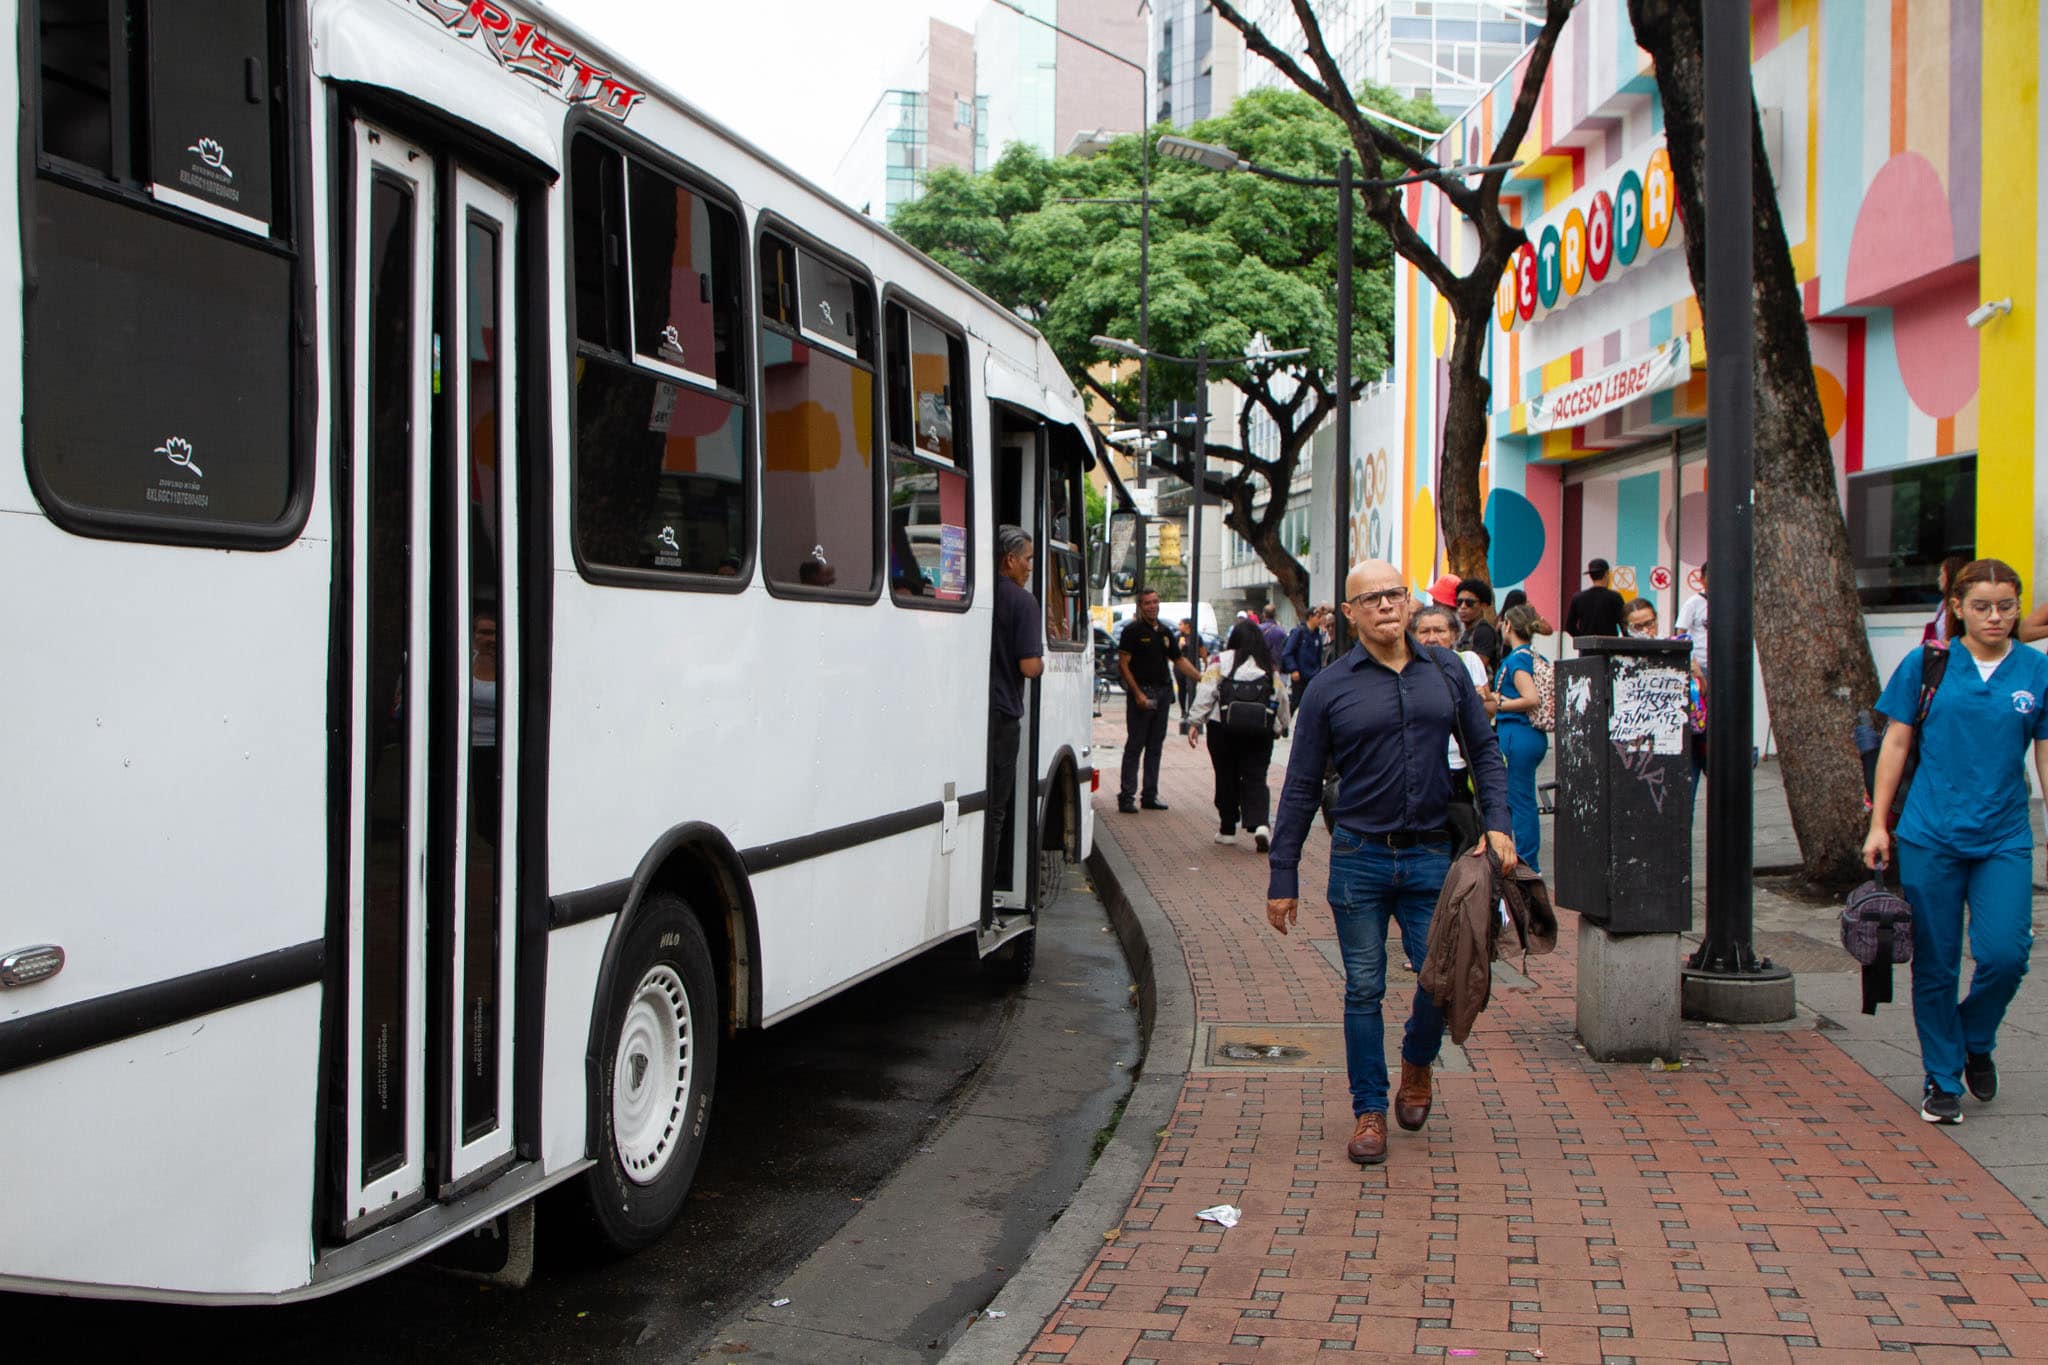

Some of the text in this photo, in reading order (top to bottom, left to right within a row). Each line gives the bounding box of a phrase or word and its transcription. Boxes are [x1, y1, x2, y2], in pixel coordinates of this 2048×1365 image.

[1498, 157, 1671, 320] METROPA
[1549, 359, 1651, 430] ¡ACCESO LIBRE!
